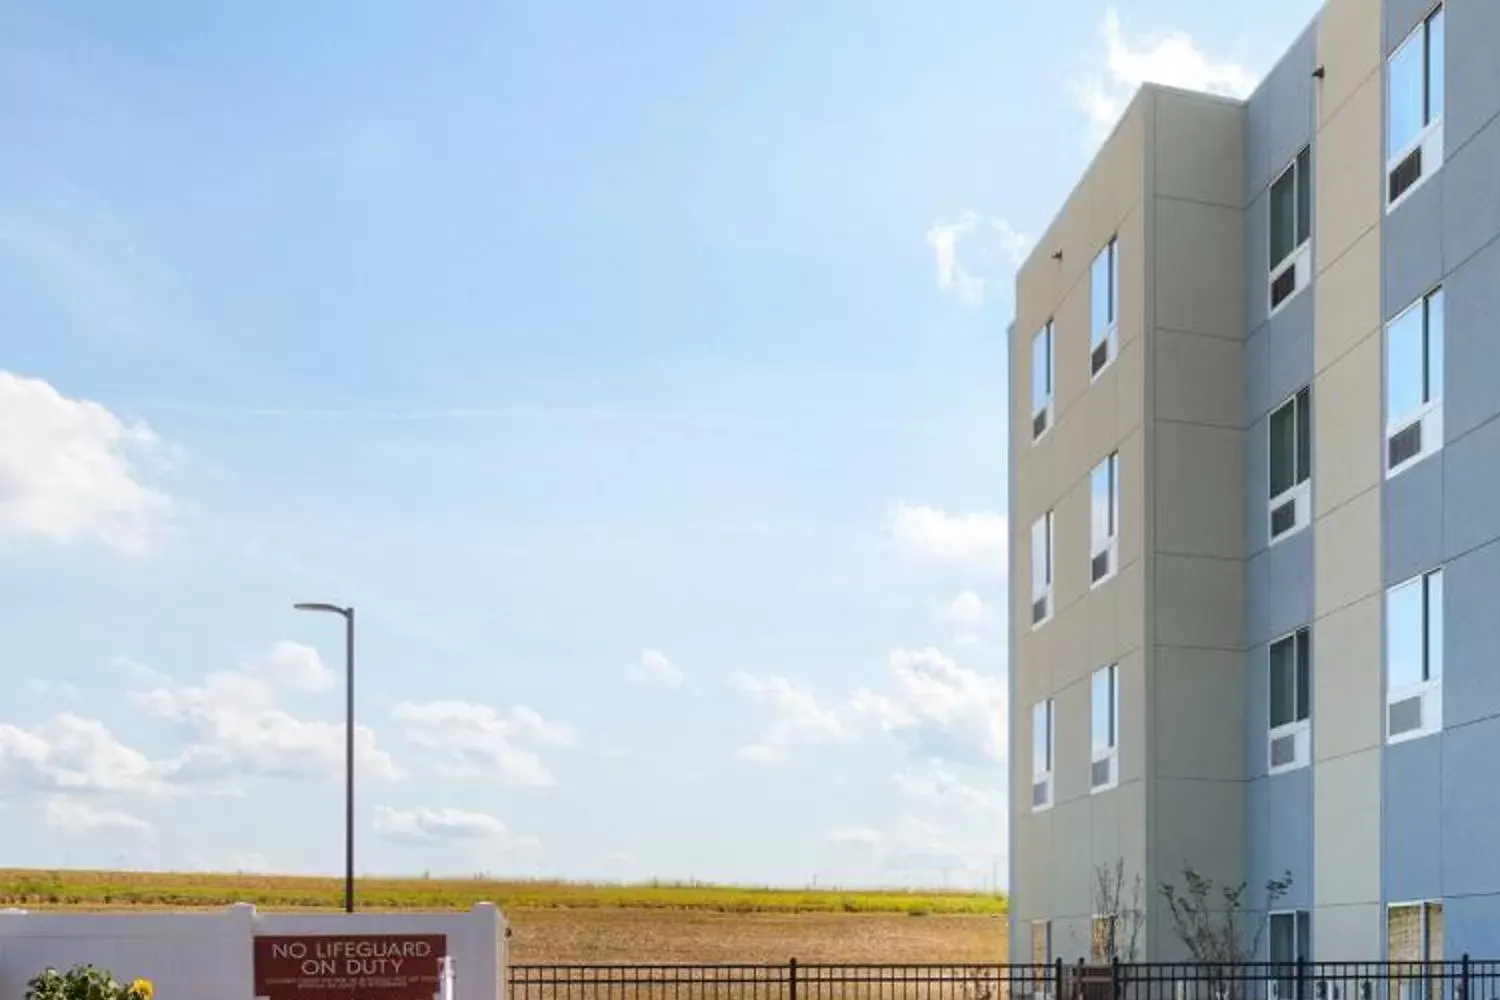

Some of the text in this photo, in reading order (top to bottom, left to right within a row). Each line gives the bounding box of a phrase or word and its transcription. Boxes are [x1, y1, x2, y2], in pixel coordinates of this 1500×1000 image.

[271, 942, 431, 959] NO LIFEGUARD
[302, 960, 404, 975] ON DUTY
